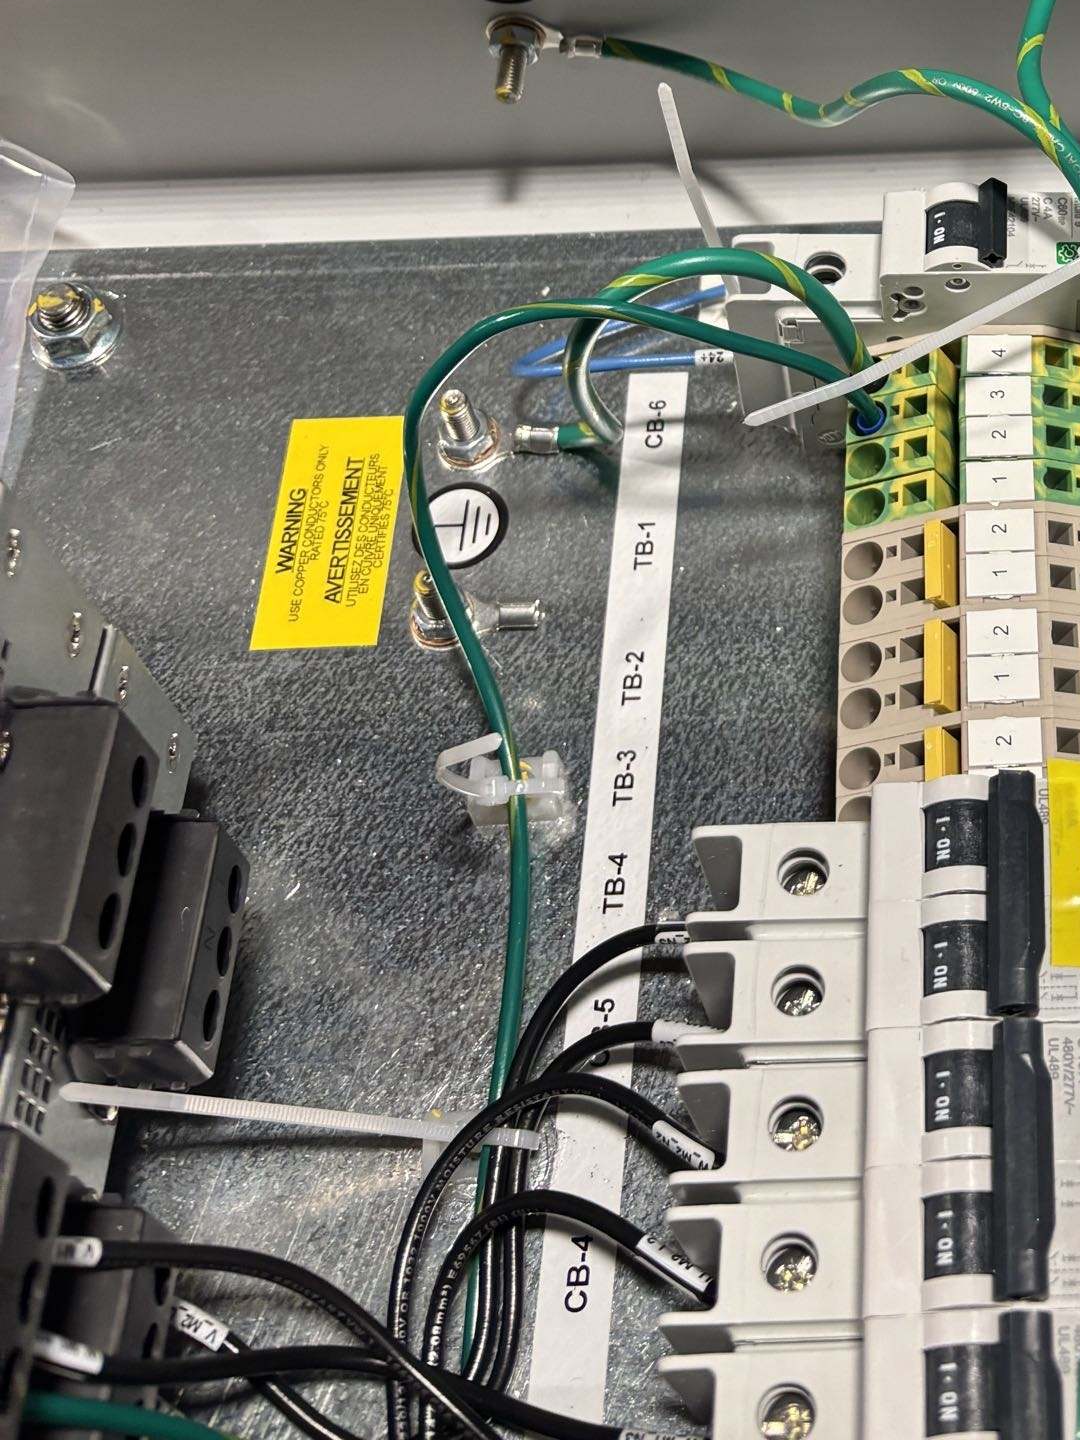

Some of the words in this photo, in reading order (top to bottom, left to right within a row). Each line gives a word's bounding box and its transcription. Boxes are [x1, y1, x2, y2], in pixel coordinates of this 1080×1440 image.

[993, 348, 1006, 358] 4
[991, 388, 1005, 399] 3
[643, 399, 669, 450] CB-6
[992, 429, 1007, 439] 2
[316, 444, 328, 469] ONLY
[358, 453, 380, 532] CONDUCTEURS
[992, 475, 1007, 484] 1
[302, 473, 324, 547] CONDUCTORS
[368, 465, 388, 533] UNIQUEMENT
[276, 487, 307, 573] WARNING
[310, 526, 324, 560] RATED
[324, 457, 364, 603] AVERTISSEMENT
[354, 535, 366, 557] DES
[633, 521, 657, 570] TB-1
[992, 523, 1007, 534] 2
[293, 550, 310, 595] COPPER
[361, 536, 377, 575] CUIVRE
[992, 567, 1007, 577] 1
[346, 559, 364, 607] UTILISEZ
[358, 577, 369, 594] EN
[289, 598, 301, 621] USE
[994, 625, 1009, 636] 2
[621, 650, 646, 708] TB-2
[994, 671, 1010, 681] 1
[995, 734, 1013, 747] 2
[612, 748, 637, 808] TB-3
[602, 852, 628, 915] TB-4
[564, 1234, 593, 1314] CB-4
